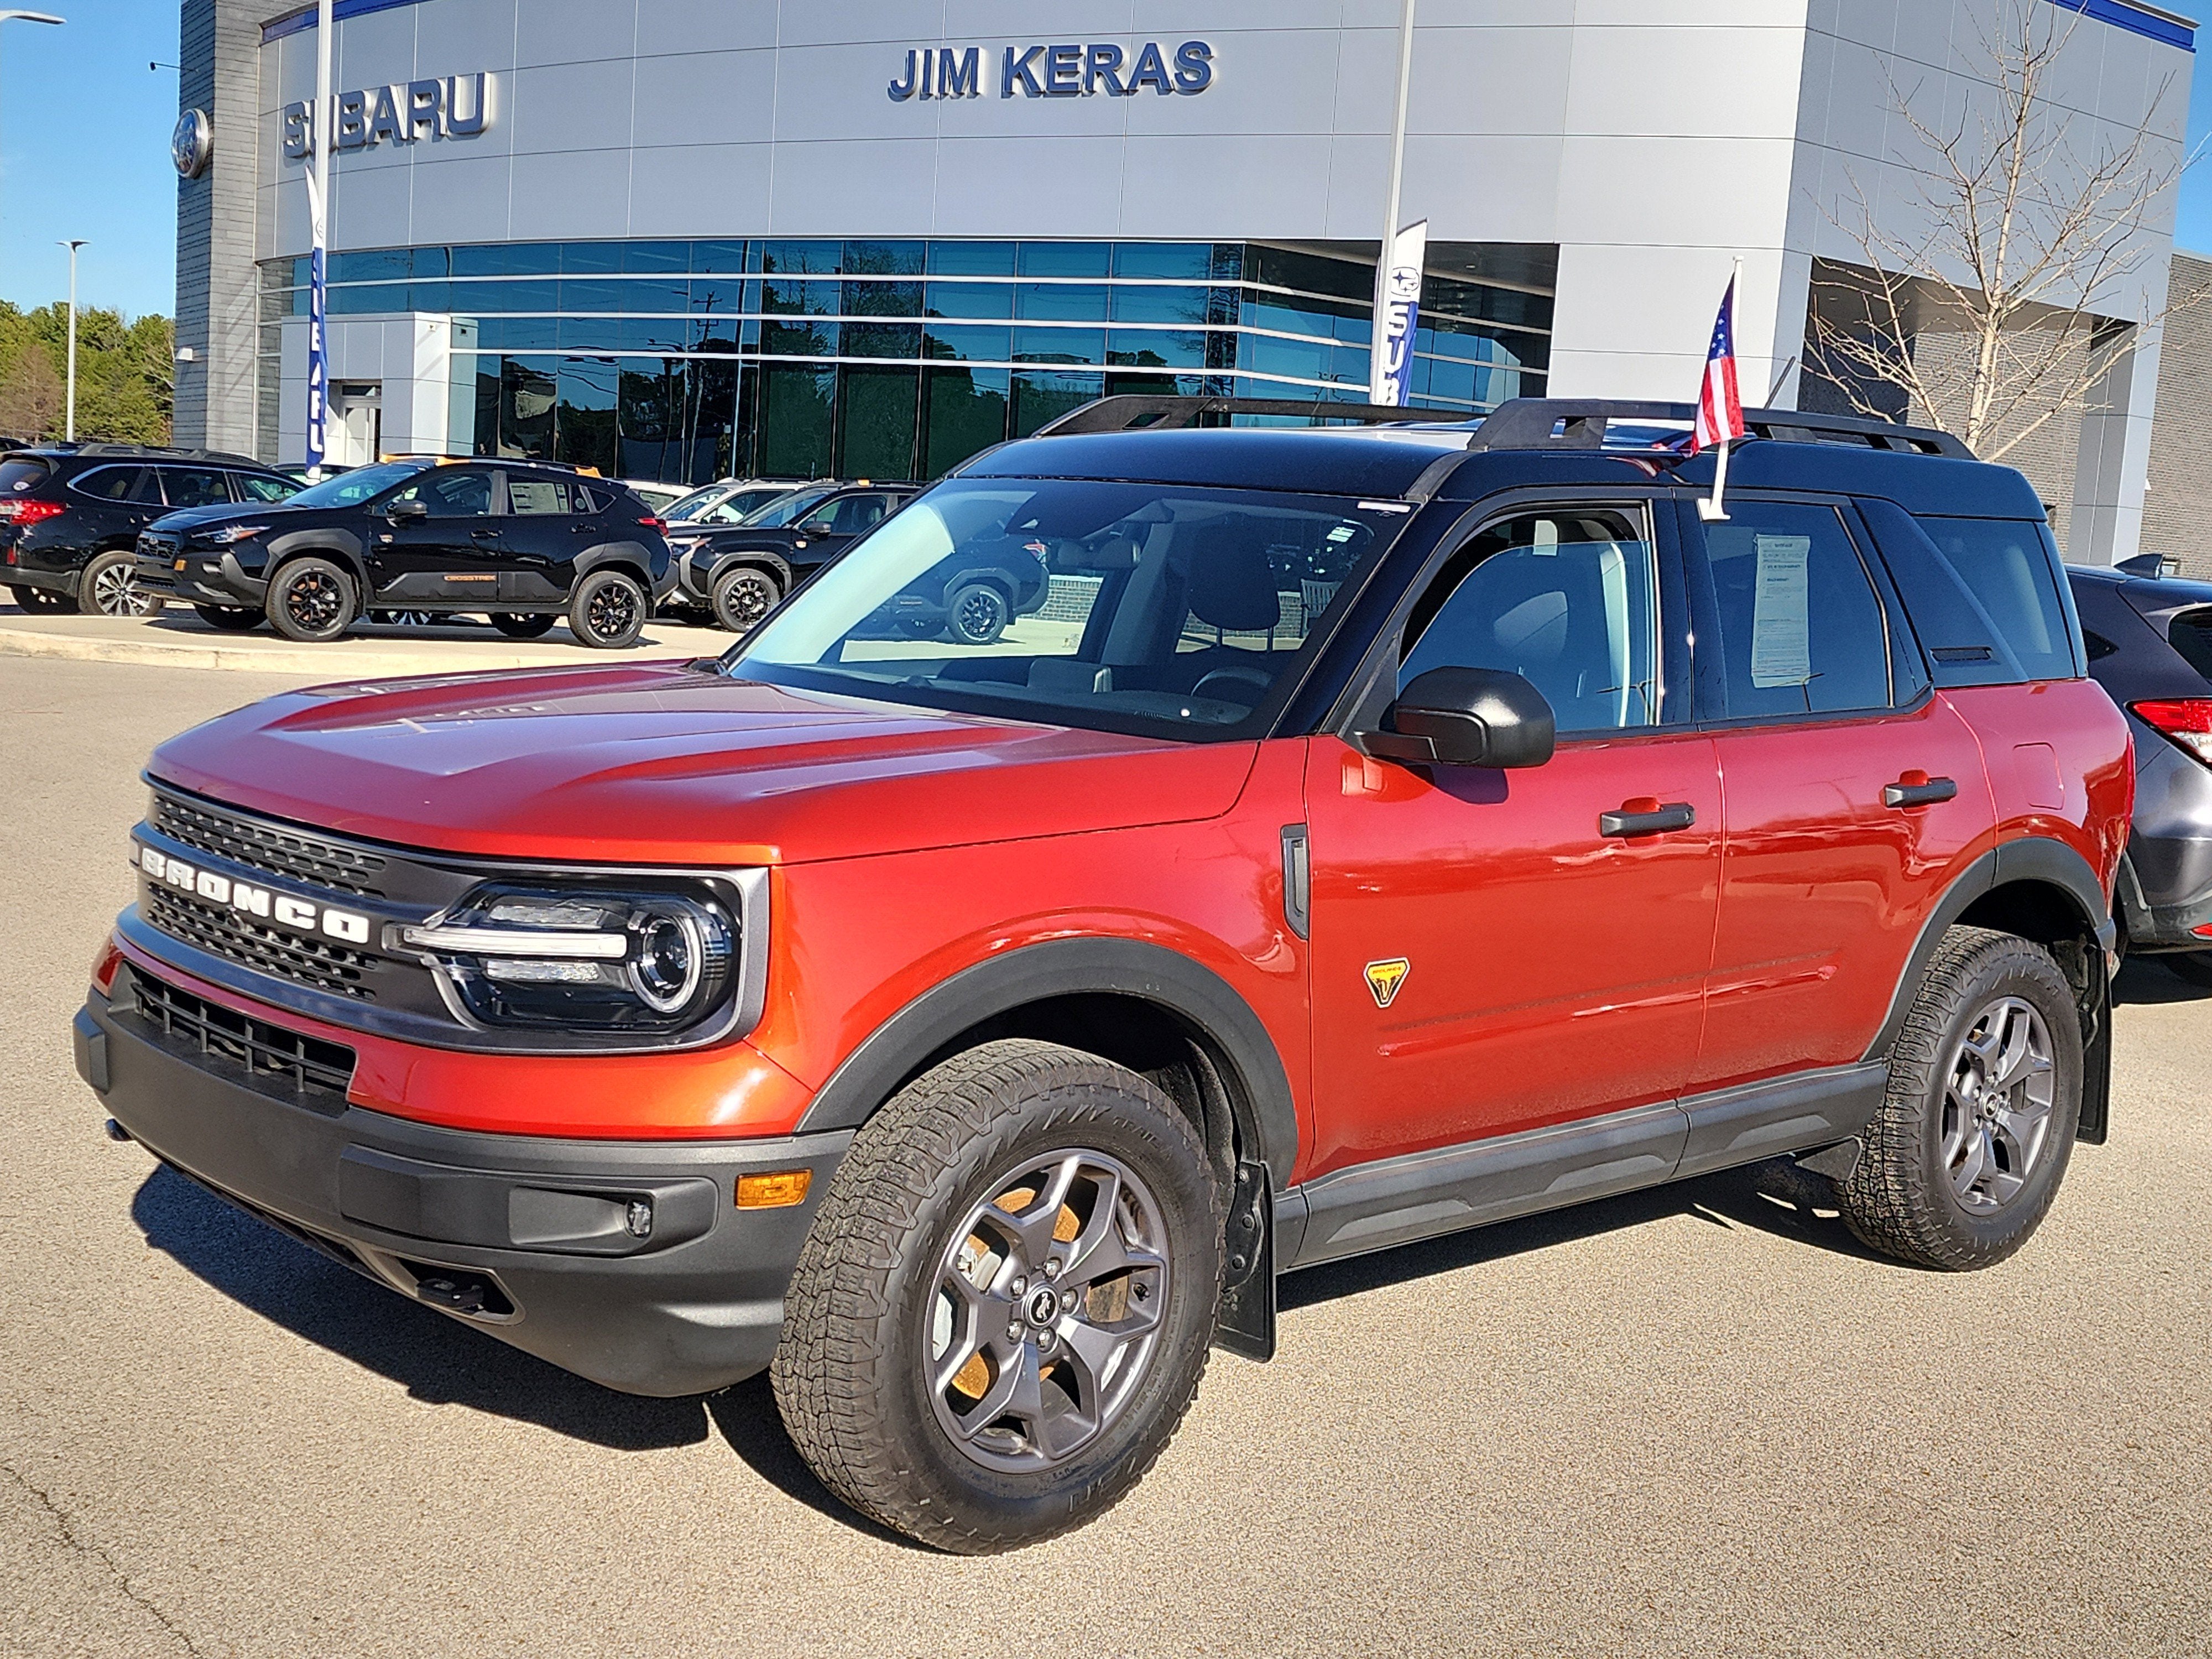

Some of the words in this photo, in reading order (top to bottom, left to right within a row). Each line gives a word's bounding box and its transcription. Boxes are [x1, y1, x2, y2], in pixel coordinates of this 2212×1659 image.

[889, 46, 982, 98] JIM
[1003, 40, 1214, 97] KERAS
[141, 847, 371, 944] BRONCO
